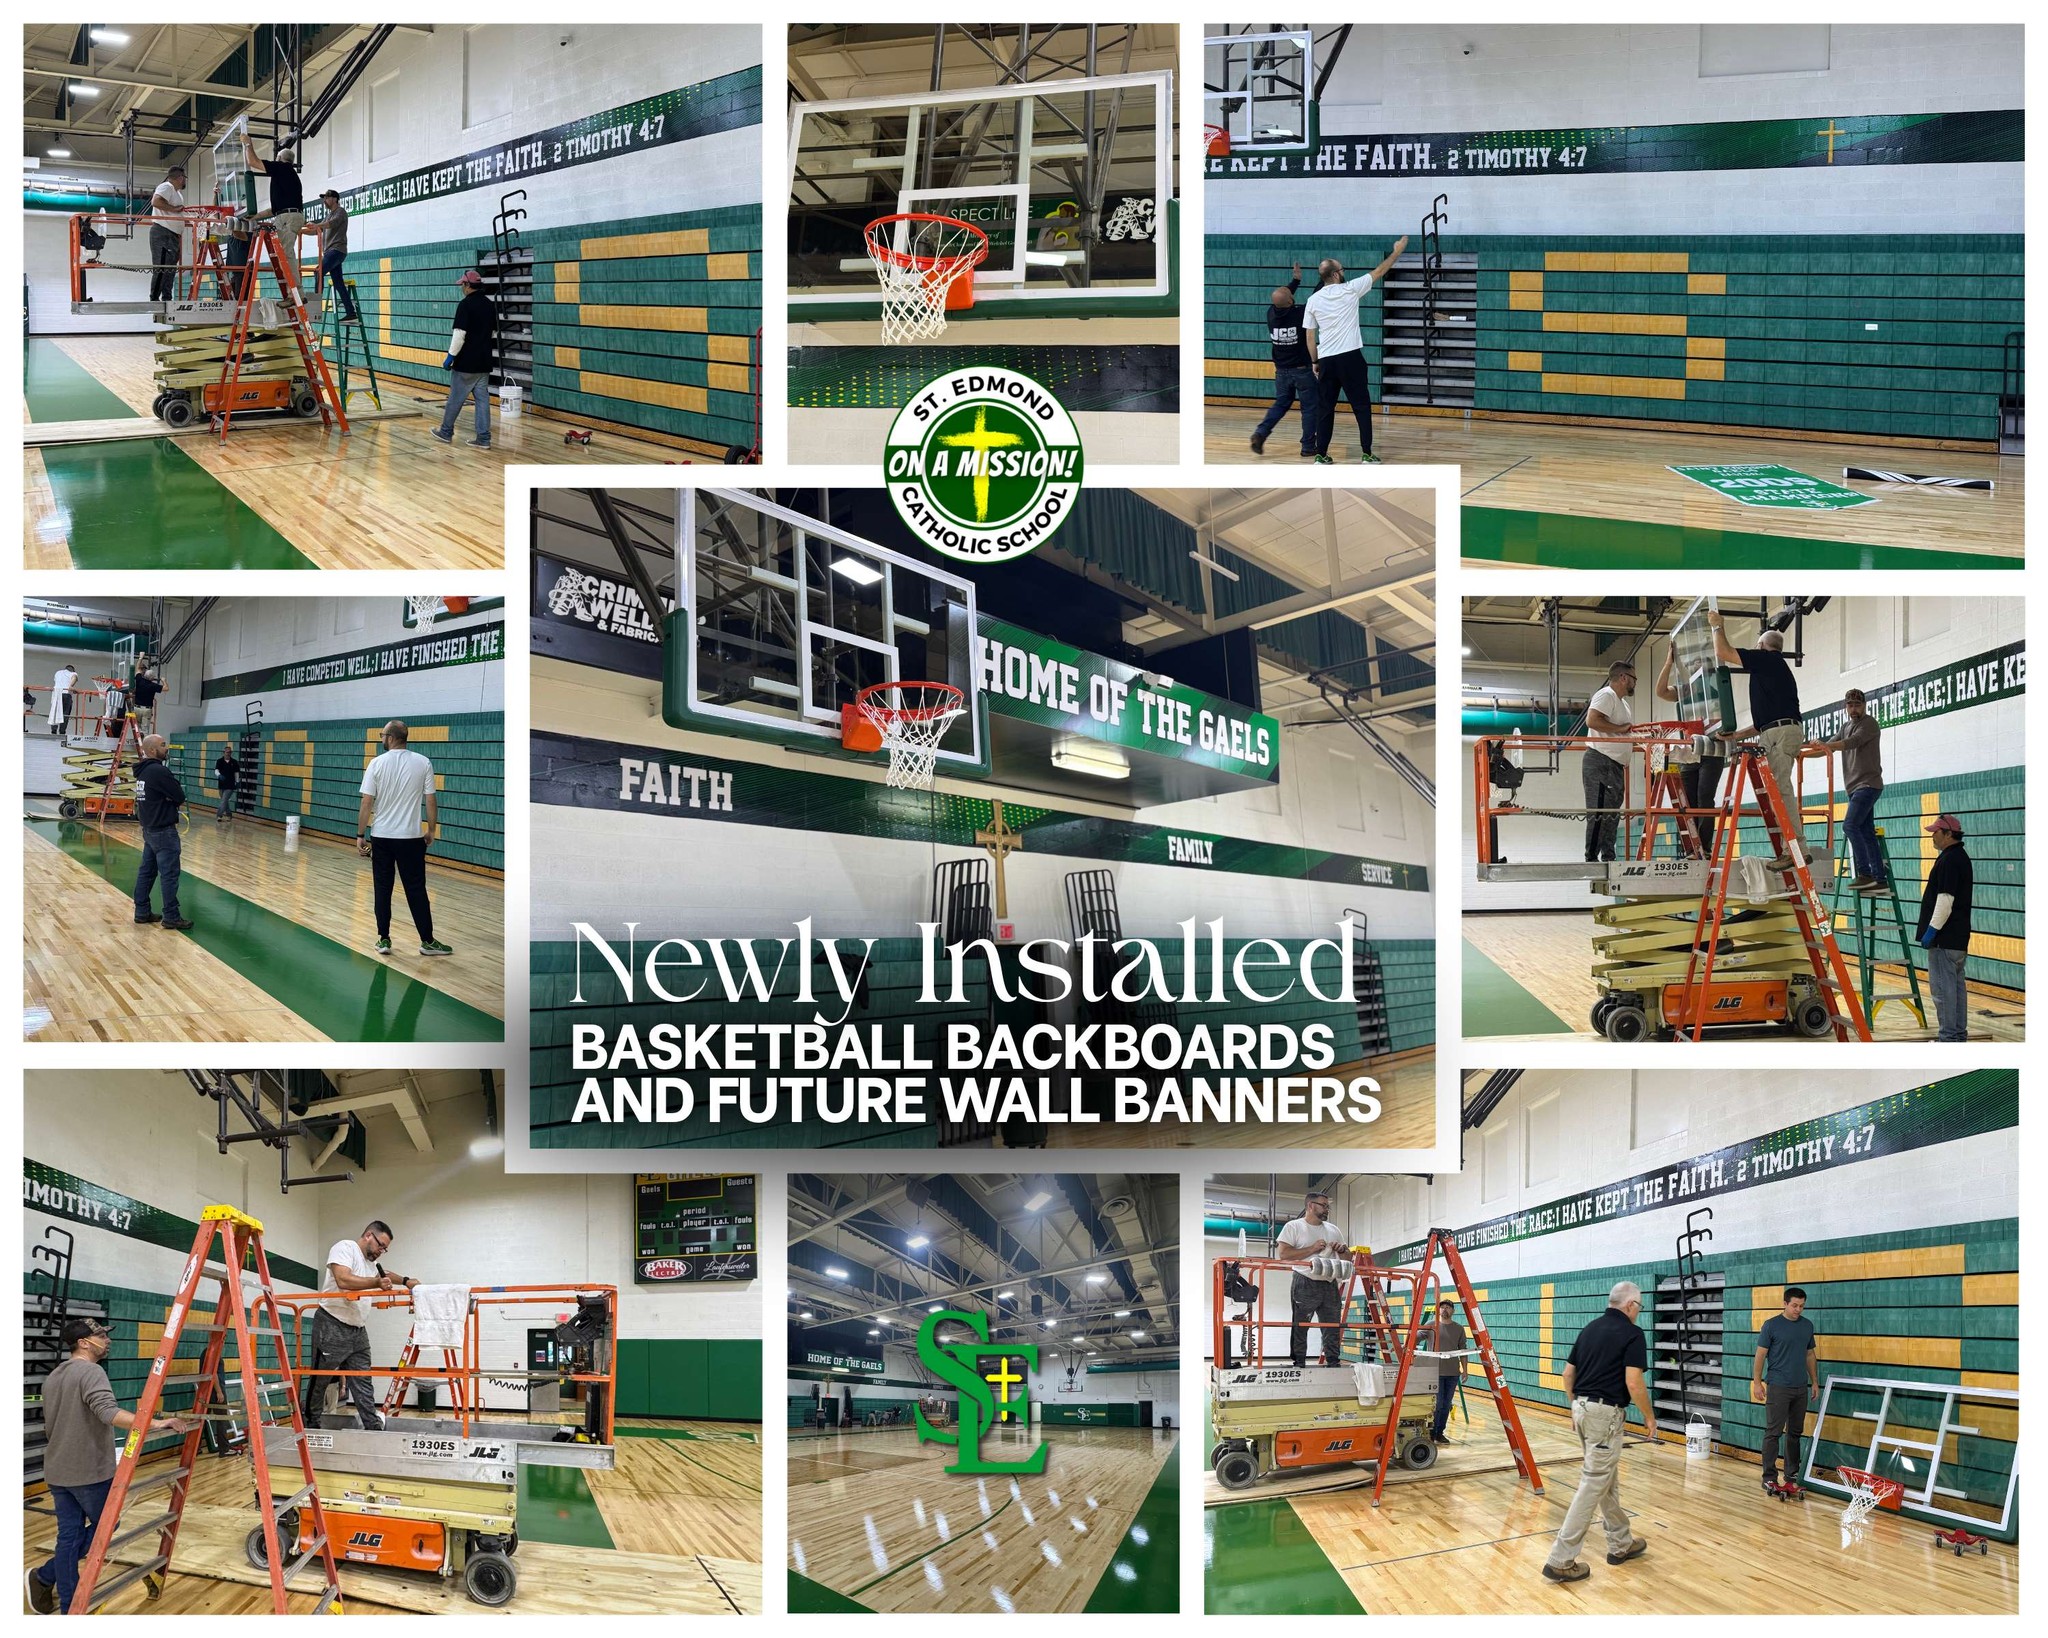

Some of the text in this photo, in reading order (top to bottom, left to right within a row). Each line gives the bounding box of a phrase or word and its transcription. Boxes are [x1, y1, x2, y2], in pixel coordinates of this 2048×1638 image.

[355, 190, 370, 210] THE
[402, 176, 429, 199] HAVE
[432, 165, 462, 192] KEPT
[466, 156, 491, 184] THE
[495, 141, 547, 177] FAITH.
[553, 143, 562, 163] 2
[565, 123, 634, 161] TIMOTHY
[639, 114, 665, 142] 4:7
[1355, 143, 1437, 170] FAITH.
[1448, 149, 1459, 169] 2
[1465, 147, 1551, 169] TIMOTHY
[1558, 146, 1587, 167] 4:7
[239, 391, 260, 401] JLG
[597, 619, 608, 631] &
[287, 667, 306, 684] HAVE
[306, 660, 345, 682] COMPETED
[381, 648, 409, 669] HAVE
[411, 636, 467, 666] FINISHED
[471, 629, 500, 657] THE
[977, 635, 1270, 766] HOME OF THE GAELS
[1807, 714, 1832, 741] HAVE
[1881, 692, 1905, 719] THE
[1956, 661, 1998, 702] HAVE
[620, 758, 733, 811] FAITH
[1167, 836, 1214, 865] FAMILY
[1361, 863, 1393, 885] SERVICE
[1622, 863, 1689, 876] JLG 1930ES
[1713, 996, 1743, 1010] JLG
[727, 1178, 753, 1187] Guests
[1458, 1233, 1475, 1249] HAVE
[1476, 1223, 1508, 1246] FINISHED
[1510, 1217, 1526, 1237] THE
[1562, 1200, 1592, 1224] HAVE
[1595, 1189, 1629, 1216] KEPT
[1633, 1176, 1663, 1207] THE
[1668, 1159, 1729, 1200] FAITH.
[1737, 1160, 1747, 1182] 2
[1752, 1135, 1834, 1178] TIMOTHY
[1842, 1124, 1876, 1155] 4:7
[23, 1176, 132, 1231] IMOTHY 4:7
[683, 1206, 706, 1216] period
[640, 1222, 656, 1230] fouls
[683, 1219, 706, 1228] player
[734, 1216, 753, 1224] fouls
[686, 1246, 704, 1255] game
[647, 1260, 687, 1272] BAKER
[807, 1353, 882, 1371] HOME OF THE GAELS
[1232, 1374, 1257, 1383] JLG
[412, 1439, 455, 1451] 1930ES
[1324, 1439, 1353, 1452] JLG
[469, 1446, 500, 1459] JLG
[349, 1532, 383, 1547] JLG
